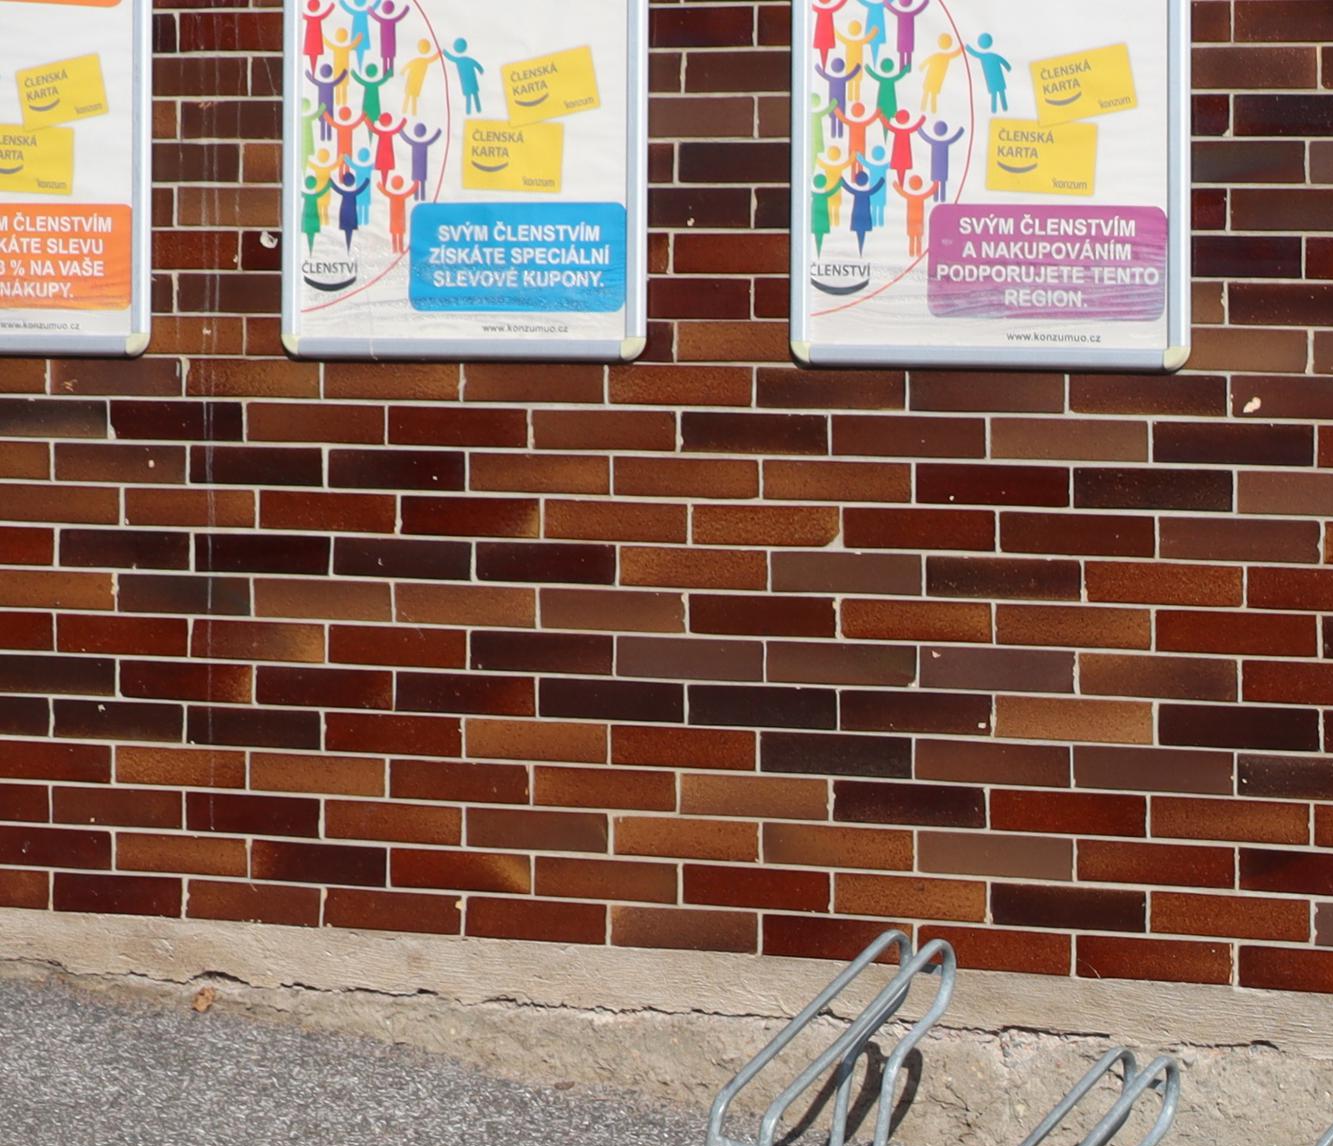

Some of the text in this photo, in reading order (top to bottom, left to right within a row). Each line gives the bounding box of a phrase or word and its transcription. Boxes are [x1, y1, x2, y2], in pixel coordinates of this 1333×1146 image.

[24, 69, 68, 88] ČLENSKÁ
[510, 62, 558, 82] ČLENSKÁ
[1040, 59, 1091, 81] ČLENSKÁ
[26, 86, 59, 101] KARTA
[512, 80, 549, 96] KARTA
[1043, 78, 1080, 95] KARTA
[0, 135, 38, 147] ENSKÁ
[472, 129, 524, 143] ČLENSKÁ
[998, 128, 1054, 144] ČLENSKÁ
[0, 149, 24, 161] ARTA
[471, 146, 509, 158] KARTA
[997, 146, 1038, 159] KARTA
[13, 212, 112, 232] ČLENSTVÍM
[438, 221, 600, 242] SVÝM ČLENSTVÍM
[959, 214, 1136, 237] SVÝM ČLENSTVÍM
[0, 234, 104, 254] KÁTE SLEVU
[962, 239, 1132, 260] A NAKUPOVÁNÍM
[429, 244, 609, 265] ZÍSKÁTE SPECIÁLNÍ
[10, 260, 25, 276] %
[30, 260, 55, 276] NA
[58, 257, 104, 276] VAŠE
[302, 260, 358, 274] ČLENSTVÍ
[810, 262, 870, 277] ČLENSTVÍ
[936, 264, 1159, 285] PODPORUJETE TENTO
[433, 268, 604, 288] SLEVOVÉ KUPONY.
[0, 279, 74, 298] NÁKUPY.
[1004, 289, 1088, 308] REGION.
[482, 324, 569, 333] www.konzumuo.cz
[1006, 332, 1101, 343] www.konzumuo.cz
